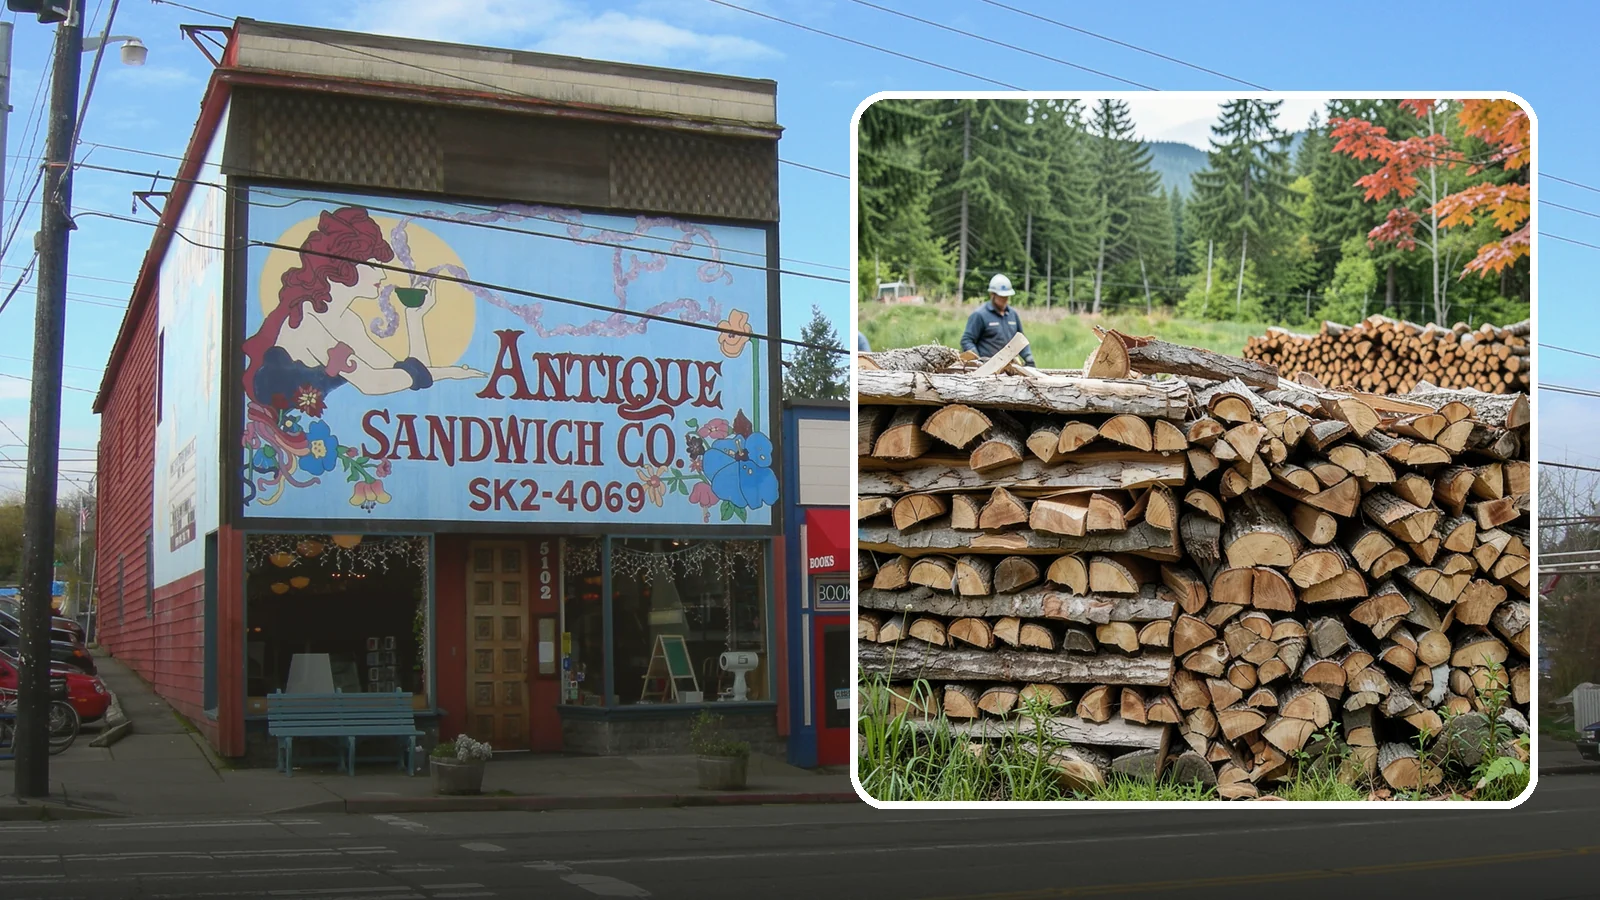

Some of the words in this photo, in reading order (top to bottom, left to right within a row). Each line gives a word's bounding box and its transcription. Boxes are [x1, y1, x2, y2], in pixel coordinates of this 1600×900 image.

[361, 408, 605, 467] SANDWICH
[617, 422, 685, 468] CO.
[468, 476, 646, 514] SK2-4069
[540, 541, 552, 600] 5102
[809, 555, 835, 569] BOOKS
